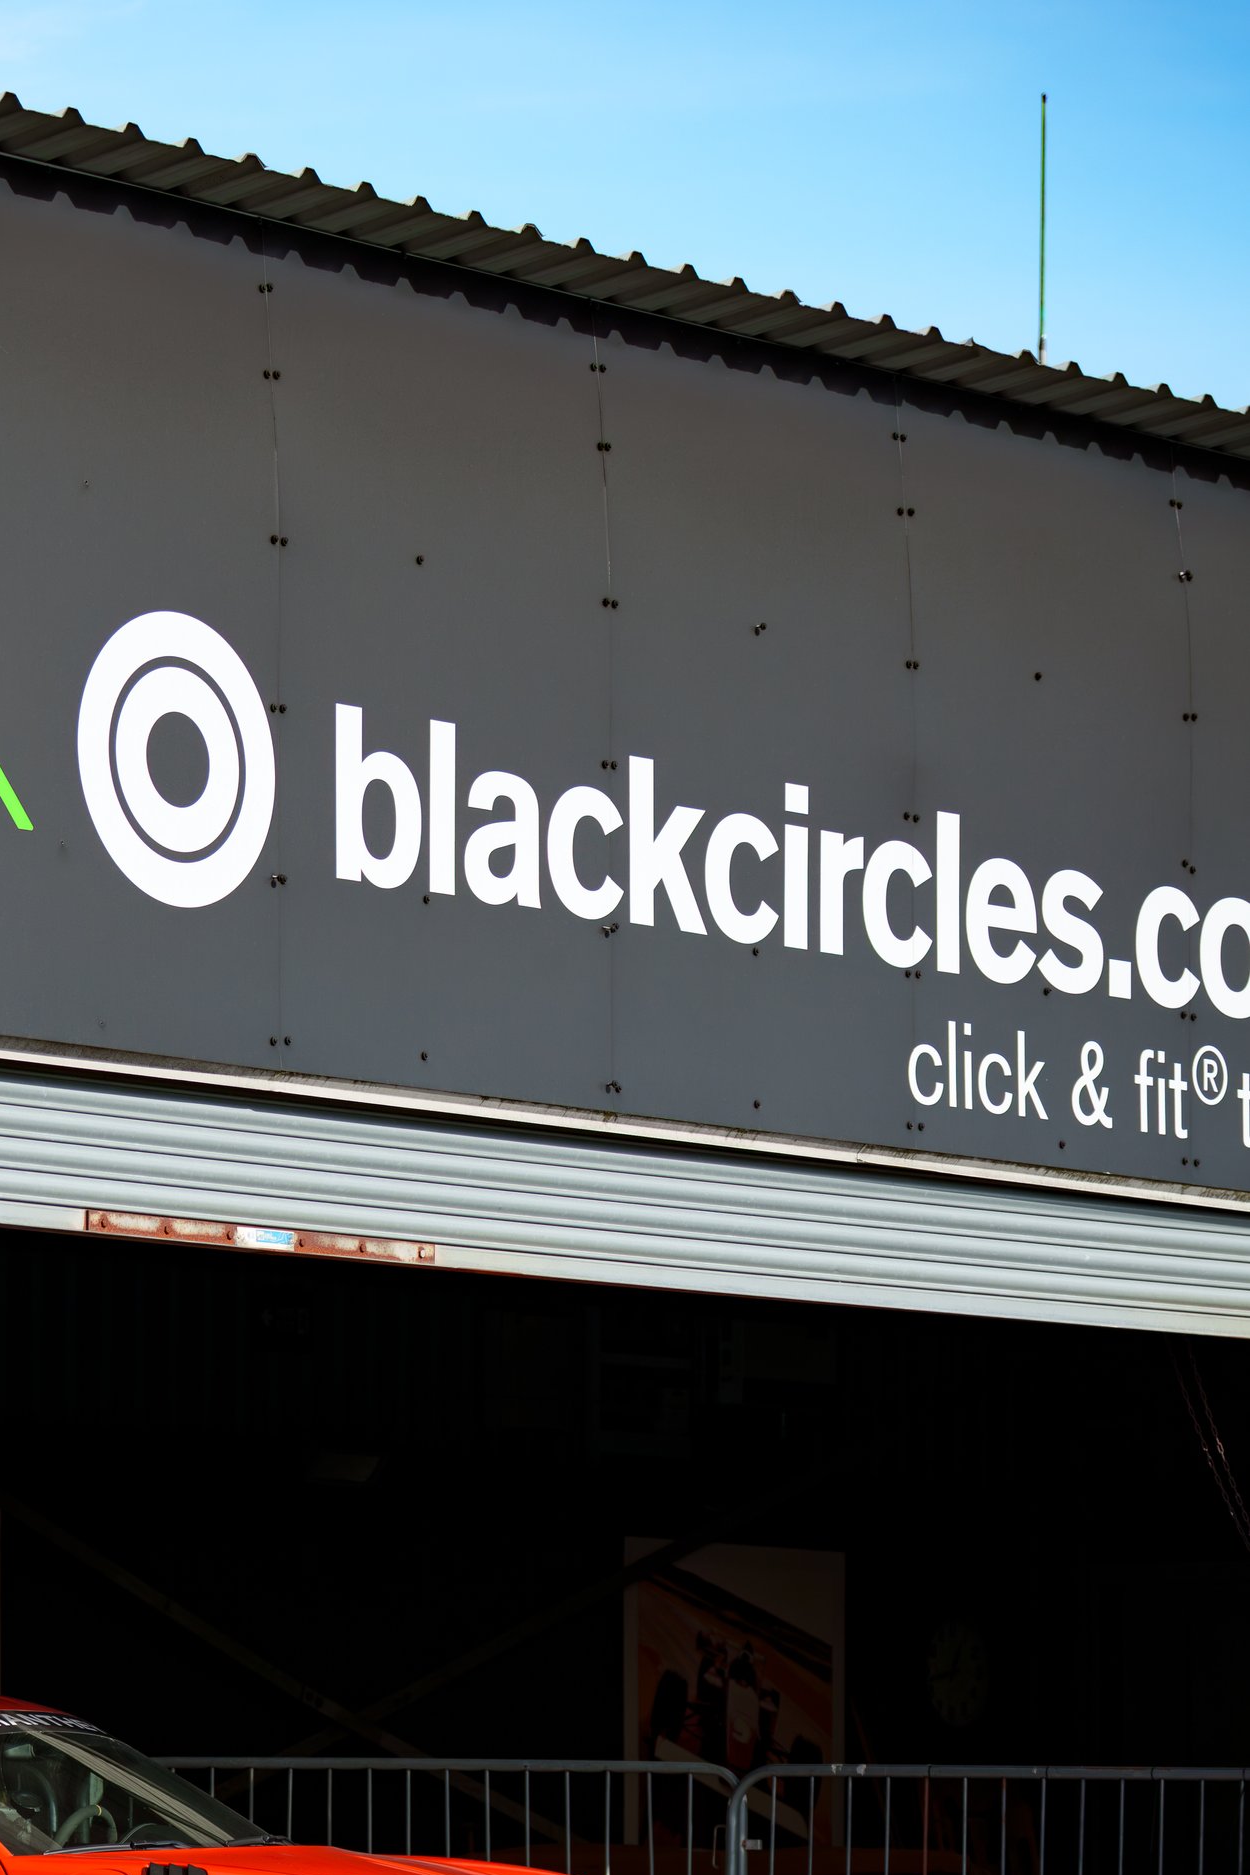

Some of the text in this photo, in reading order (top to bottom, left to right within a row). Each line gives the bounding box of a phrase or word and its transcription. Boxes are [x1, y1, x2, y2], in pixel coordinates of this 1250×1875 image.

[335, 702, 1250, 1020] blackcircles.co
[908, 1020, 1049, 1120] click
[1071, 1040, 1113, 1130] &
